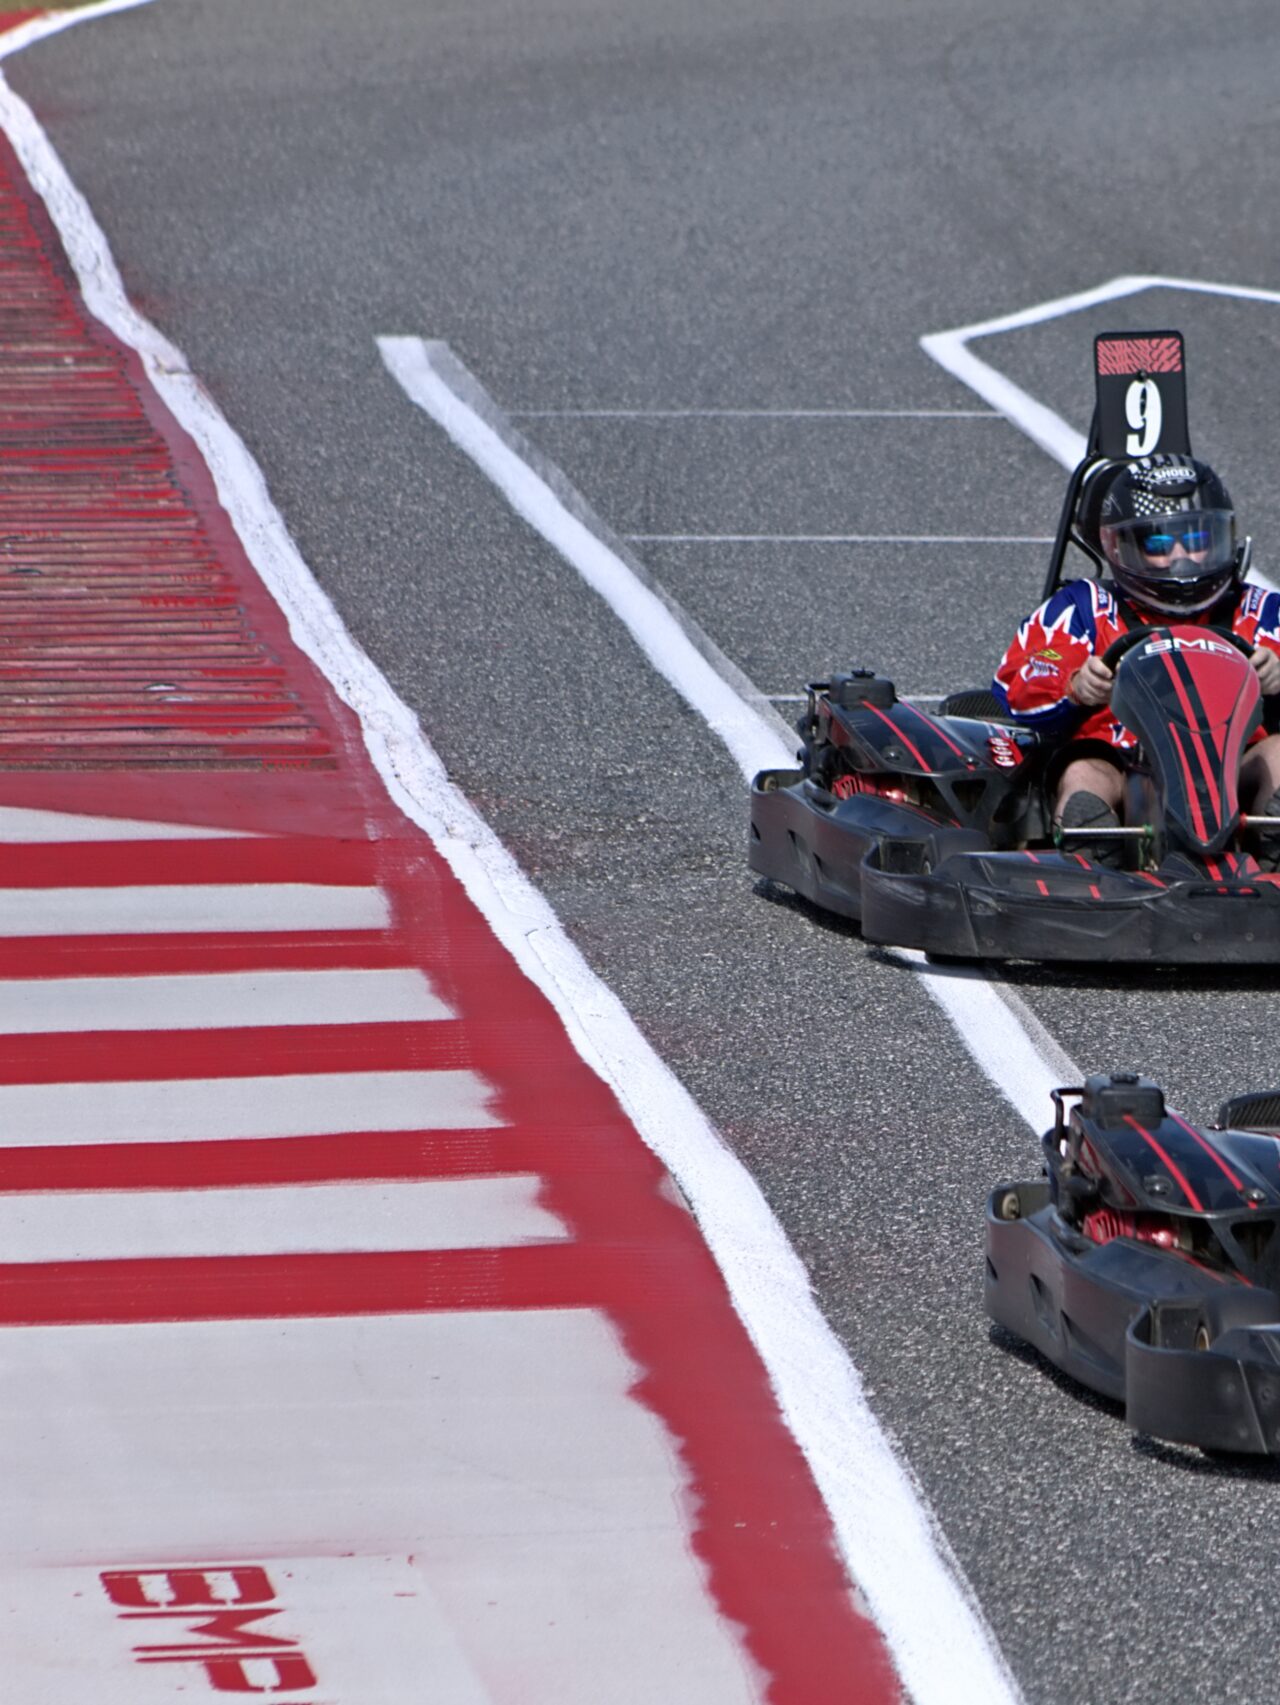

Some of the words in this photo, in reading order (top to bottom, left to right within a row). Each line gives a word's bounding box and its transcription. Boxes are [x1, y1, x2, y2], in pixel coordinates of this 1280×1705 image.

[1125, 379, 1162, 457] 9
[1144, 637, 1233, 655] BMP
[100, 1566, 317, 1693] BMP
